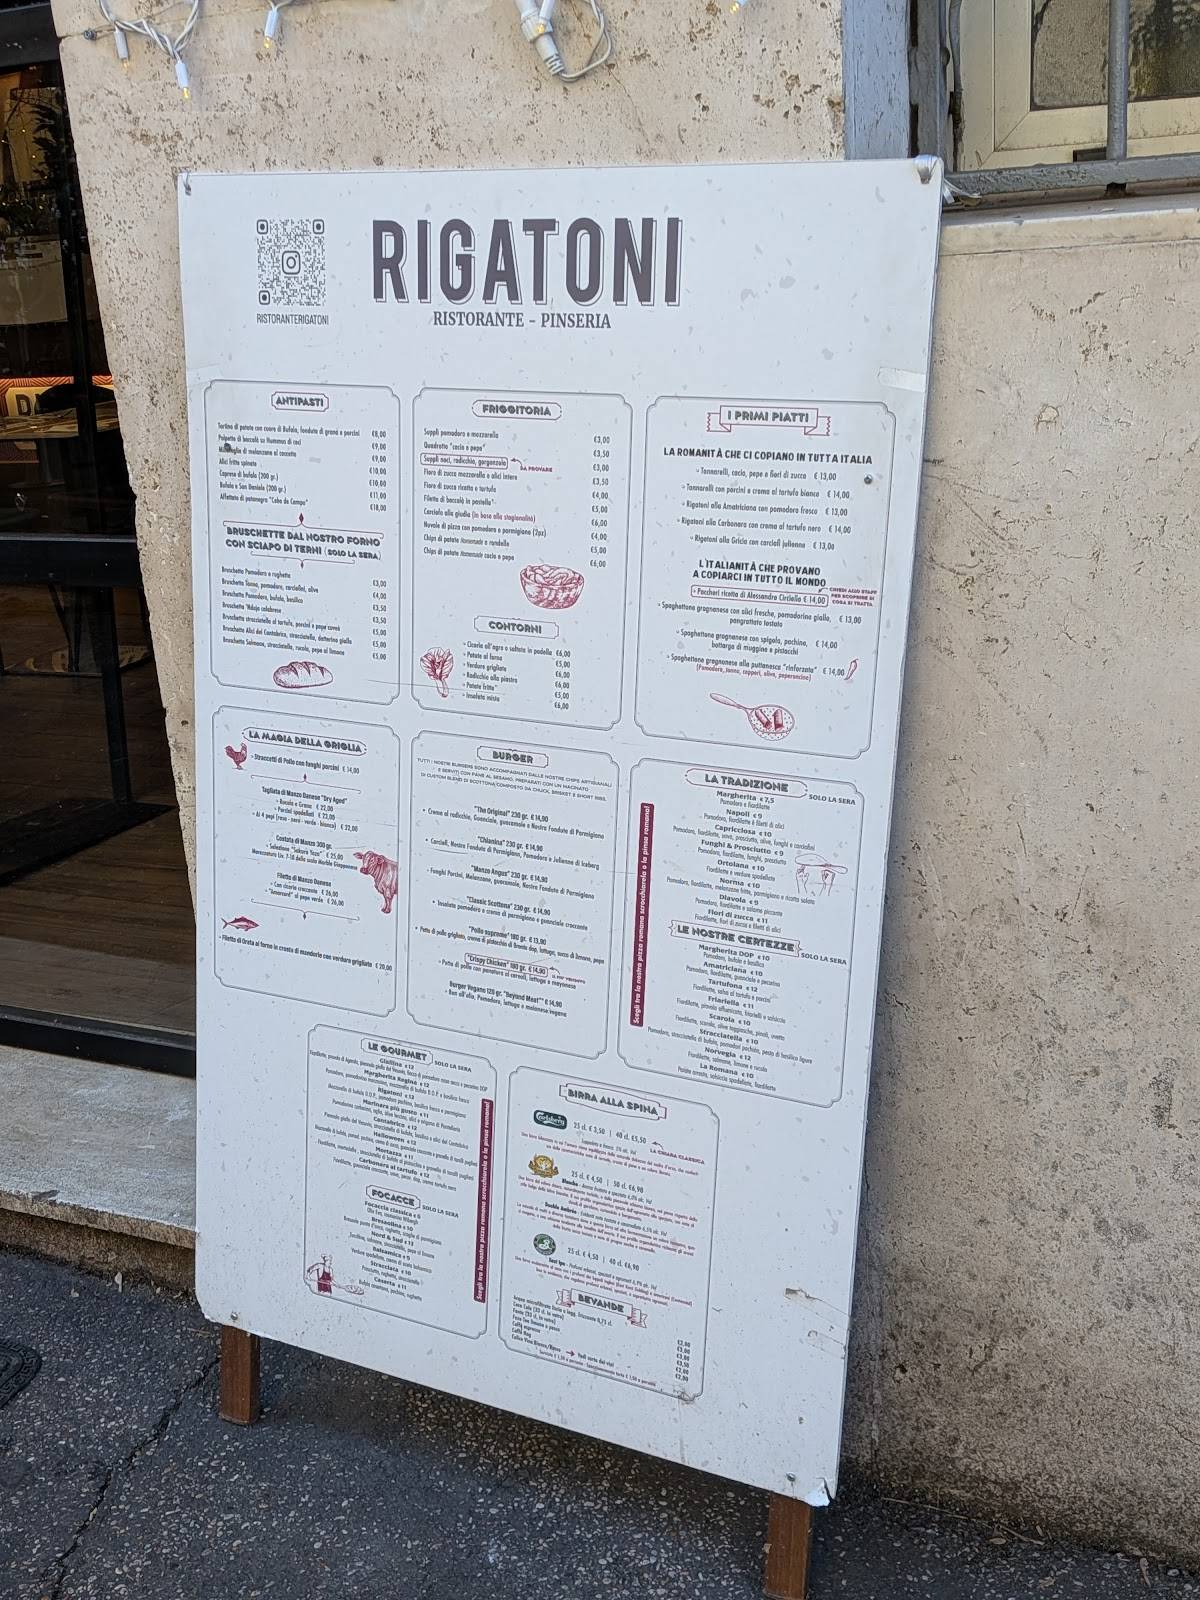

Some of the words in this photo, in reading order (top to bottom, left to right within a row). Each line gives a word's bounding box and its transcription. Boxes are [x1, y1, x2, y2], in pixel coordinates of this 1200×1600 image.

[372, 218, 682, 306] RIGATONI
[256, 313, 329, 325] RISTORANTERIGATONI
[433, 311, 524, 327] RISTORANTE
[541, 313, 611, 329] PINSERIA
[276, 396, 324, 407] ANTIPASTI
[482, 404, 551, 416] FRIGGITORIA
[727, 410, 731, 420] I
[735, 411, 768, 422] PRIMI
[772, 412, 809, 422] PIATTI
[664, 447, 675, 457] LA
[678, 448, 722, 458] ROMANITÀ
[725, 450, 741, 460] CHE
[744, 451, 752, 460] CI
[754, 451, 794, 462] COPIANO
[796, 453, 806, 462] IN
[808, 453, 838, 463] TUTTA
[840, 454, 872, 464] ITALIA
[226, 527, 285, 539] BRUSCHETTE
[288, 532, 305, 541] DAL
[306, 534, 344, 544] NOSTRO
[347, 536, 380, 546] FORNO
[226, 539, 246, 548] CON
[248, 541, 281, 551] SCIAPO
[295, 545, 322, 555] TERNI
[759, 563, 775, 573] CHE
[778, 565, 821, 576] PROVANO
[701, 571, 741, 581] COPIARCI
[755, 574, 782, 584] TUTTO
[785, 576, 793, 585] IL
[796, 578, 826, 587] MONDO
[489, 621, 542, 634] CONTORNI
[249, 730, 260, 739] LA
[262, 732, 293, 744] MAGIA
[295, 736, 322, 748] DELLA
[324, 740, 362, 753] GRIGLIA
[492, 751, 534, 764] BURGER
[705, 774, 719, 784] LA
[721, 776, 788, 792] TRADIZIONE
[809, 794, 827, 802] SOLO
[838, 797, 856, 805] SERA
[717, 790, 757, 802] Margherita
[726, 809, 750, 819] Napoli
[714, 824, 756, 836] Capricciosa
[701, 839, 726, 850] Funghi
[734, 844, 771, 855] Prosciutto
[717, 859, 749, 870] Ortolana
[719, 877, 744, 887] Norma
[719, 894, 746, 904] Diavola
[677, 925, 689, 935] LE
[692, 927, 735, 942] NOSTRE
[738, 935, 795, 952] CERTEZZE
[801, 953, 818, 961] SOLO
[830, 956, 847, 965] SERA
[739, 951, 754, 959] DOP
[368, 1042, 378, 1051] LE
[380, 1045, 427, 1062] GOURMET
[568, 1089, 598, 1104] BIRRA
[600, 1096, 625, 1109] ALLA
[626, 1101, 658, 1116] SPINA
[371, 1188, 415, 1207] FOCACCE
[578, 1293, 625, 1313] BEVANDE
